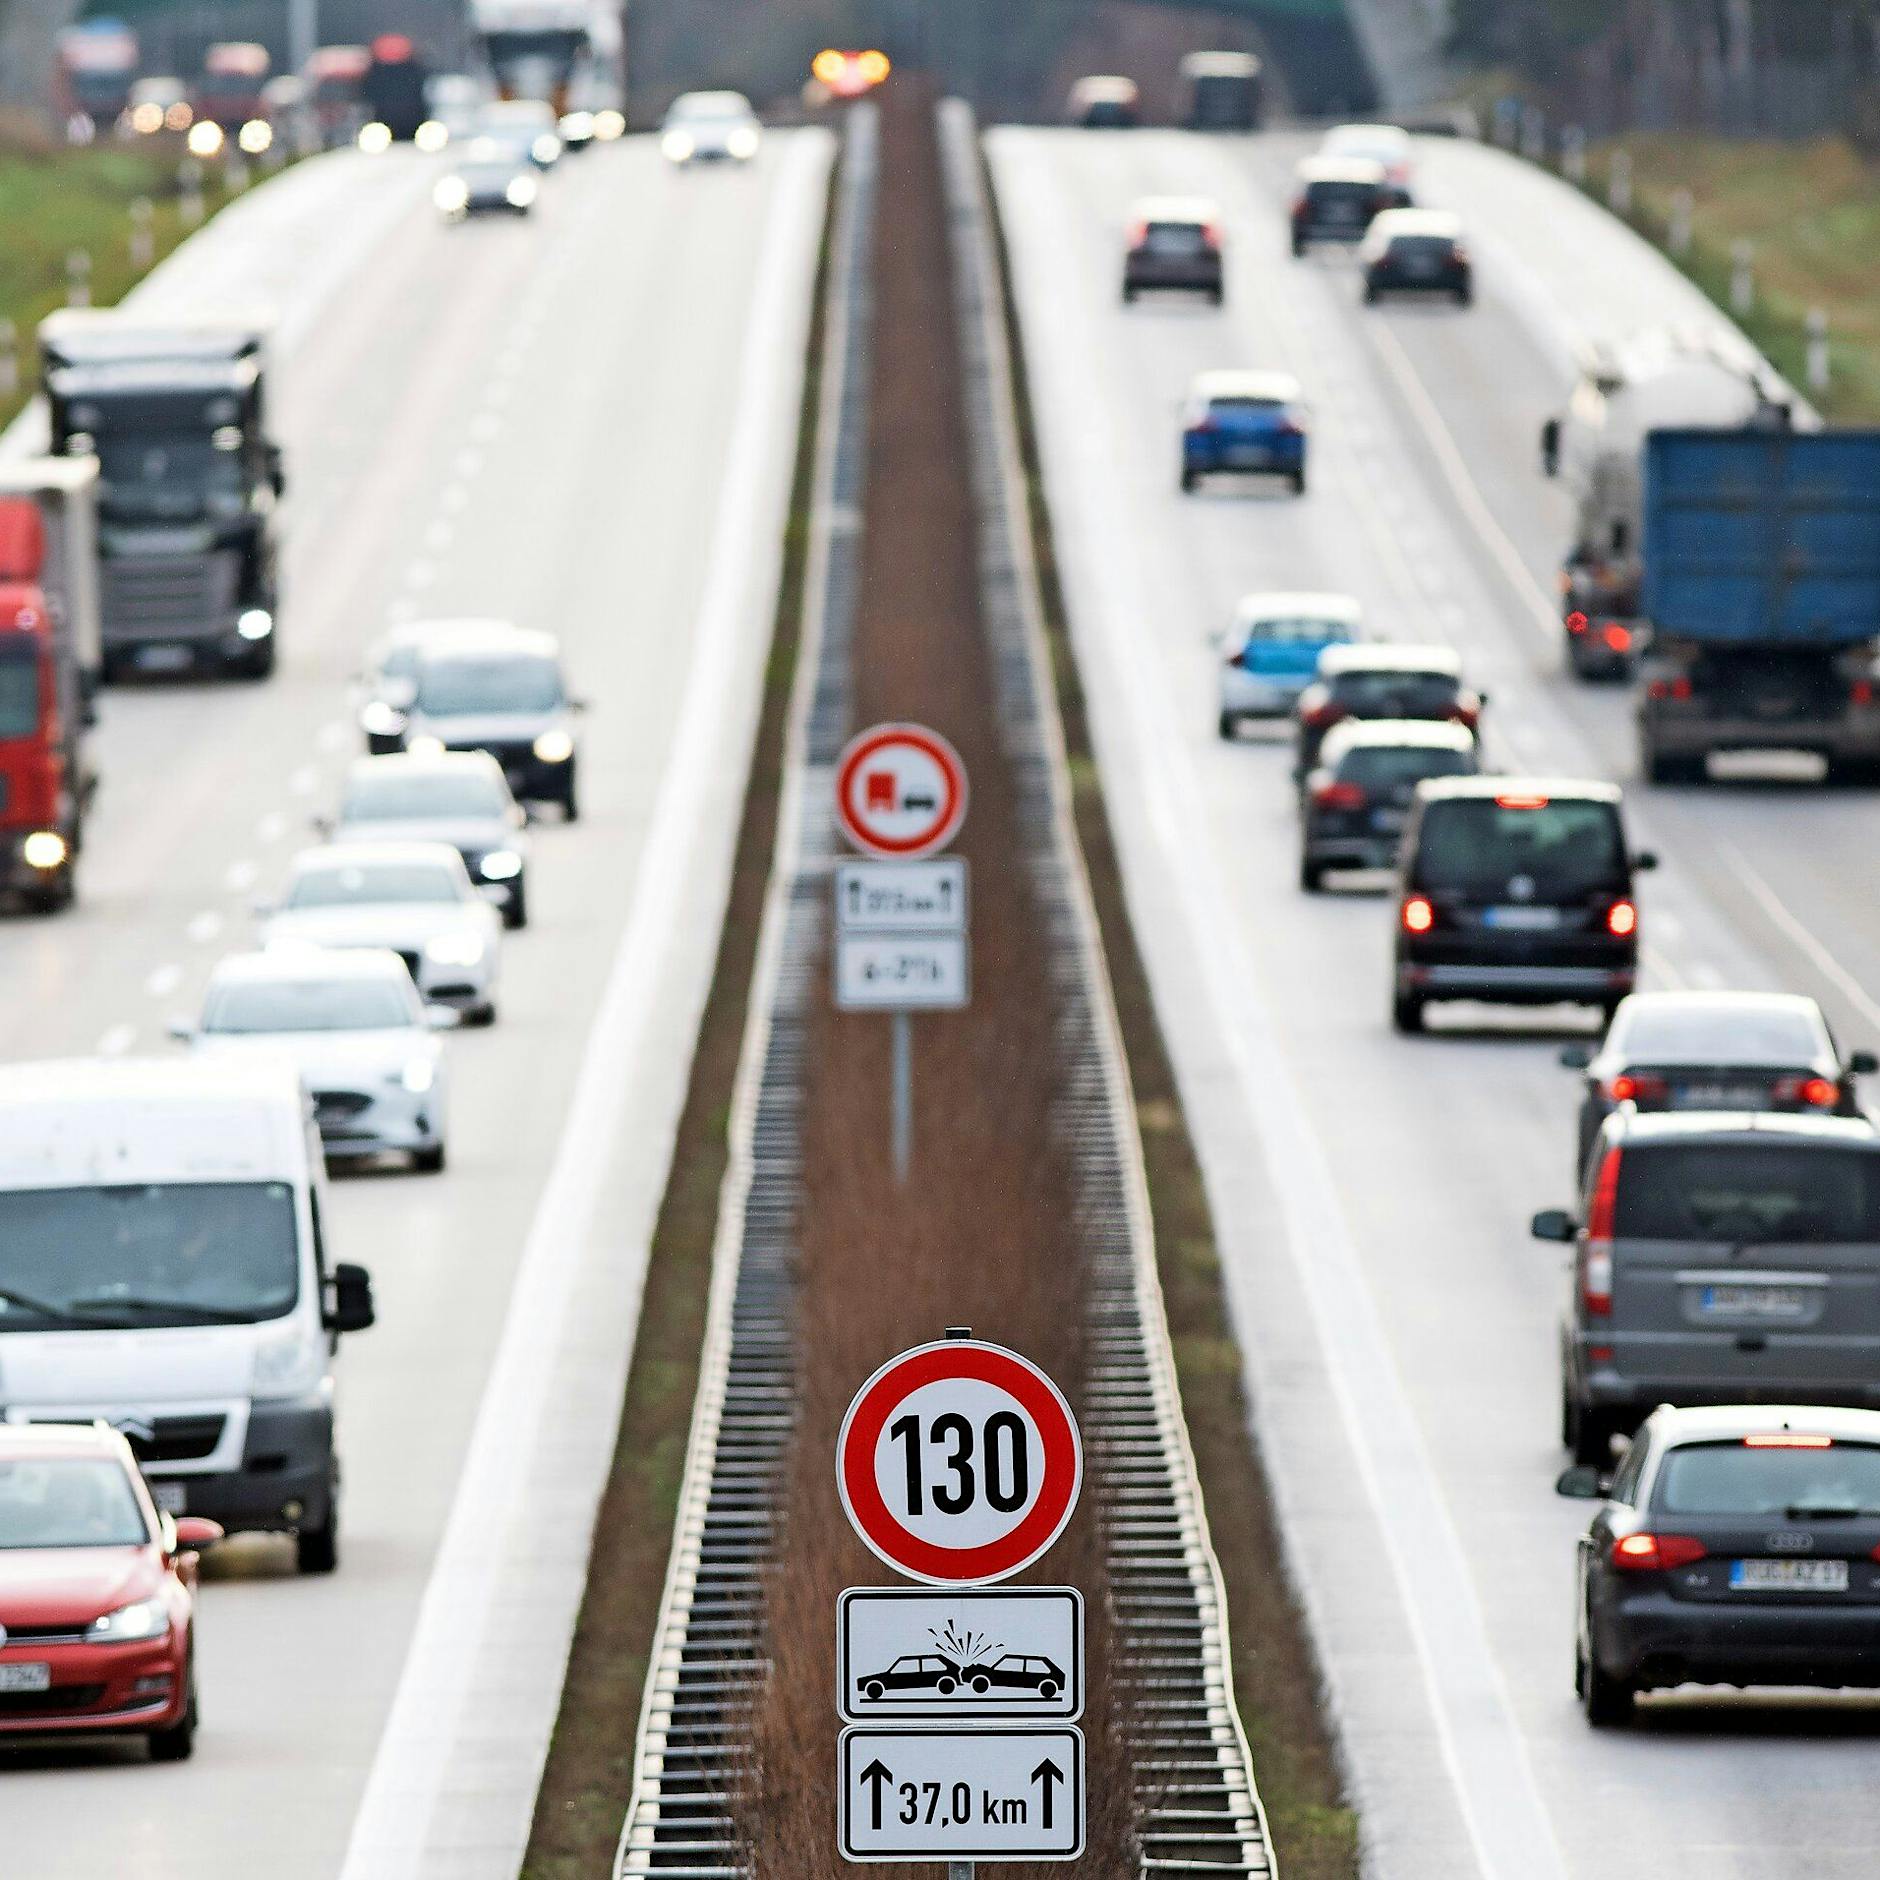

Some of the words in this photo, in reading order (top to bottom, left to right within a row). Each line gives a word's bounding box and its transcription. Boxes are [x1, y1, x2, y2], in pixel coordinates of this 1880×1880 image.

[890, 1410, 1028, 1516] 130
[899, 1781, 971, 1829] 37,0
[983, 1790, 1027, 1824] km
